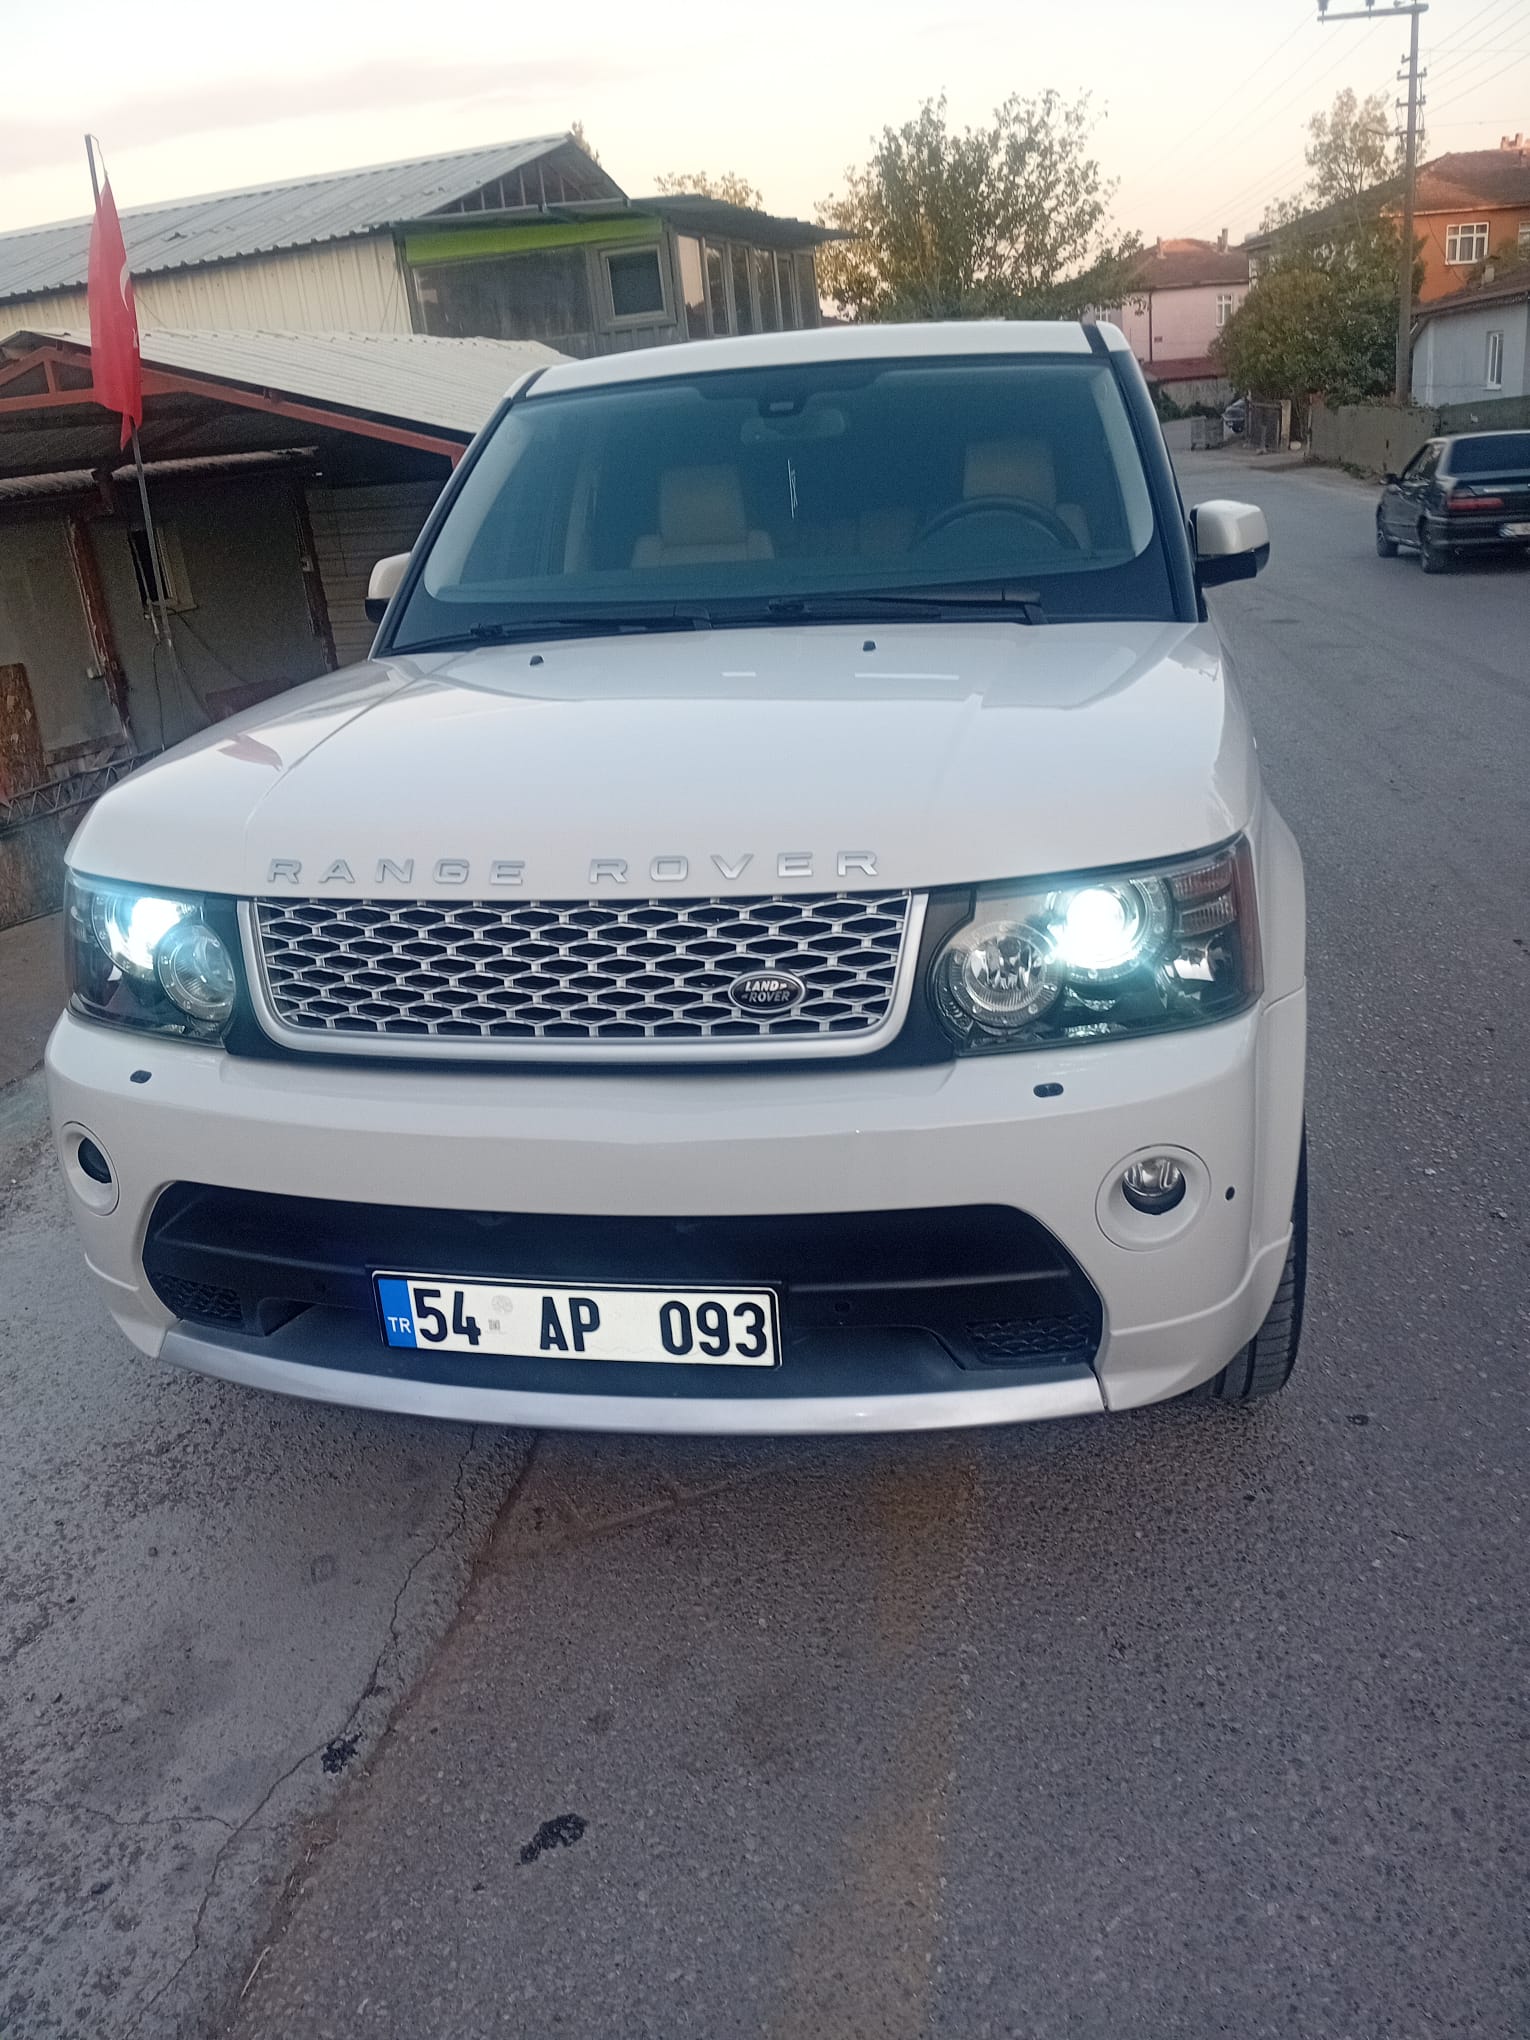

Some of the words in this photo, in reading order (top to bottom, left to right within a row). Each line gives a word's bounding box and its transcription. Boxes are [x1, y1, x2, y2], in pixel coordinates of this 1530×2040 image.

[267, 858, 526, 885] RANGE
[589, 850, 879, 883] ROVER
[745, 980, 779, 991] LAND
[749, 991, 790, 1002] ROVER
[387, 1316, 412, 1334] TR
[413, 1288, 481, 1345] 54
[540, 1296, 600, 1352] AP
[659, 1300, 767, 1358] 093
